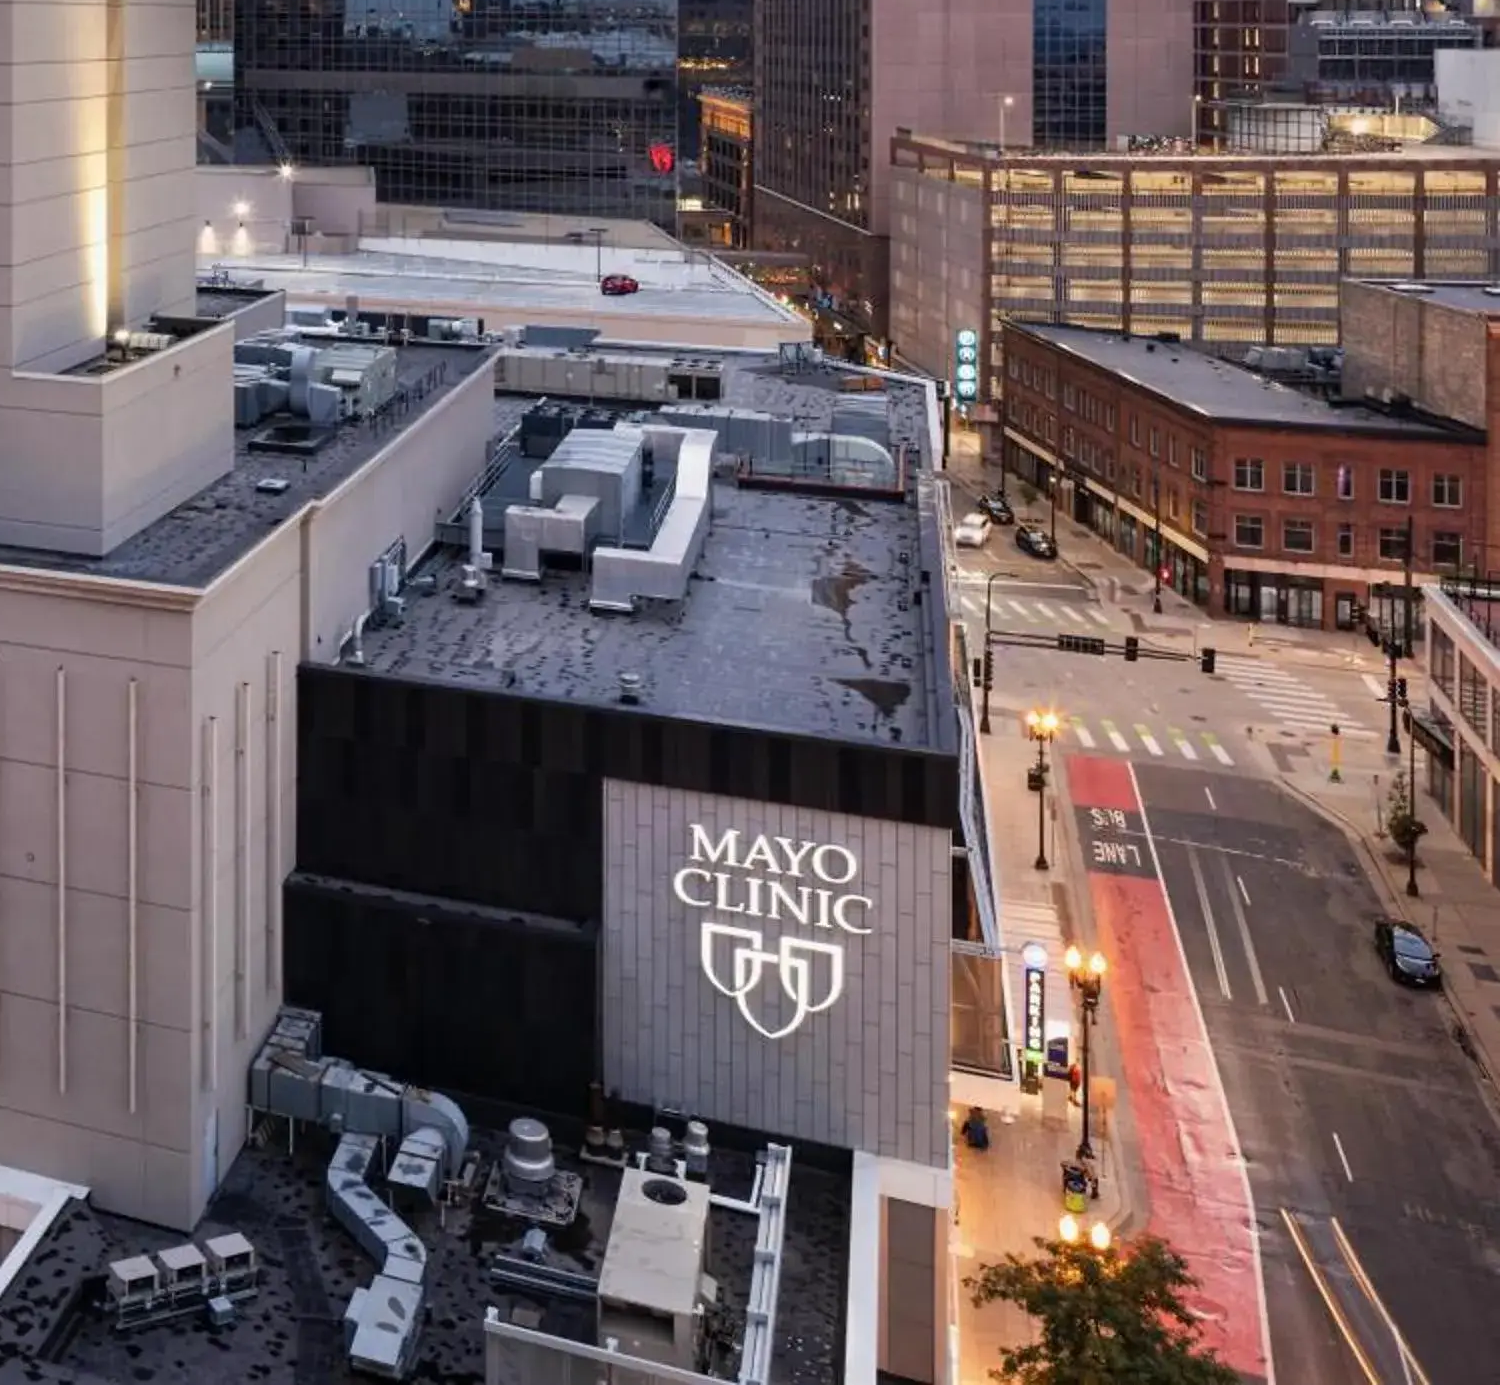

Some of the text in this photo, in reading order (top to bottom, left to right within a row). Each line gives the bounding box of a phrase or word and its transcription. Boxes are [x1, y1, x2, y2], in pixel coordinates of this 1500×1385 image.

[688, 823, 857, 885] MAYO
[1091, 841, 1142, 867] LANE
[672, 867, 874, 935] CLINIC
[1029, 971, 1042, 1050] PARKING
